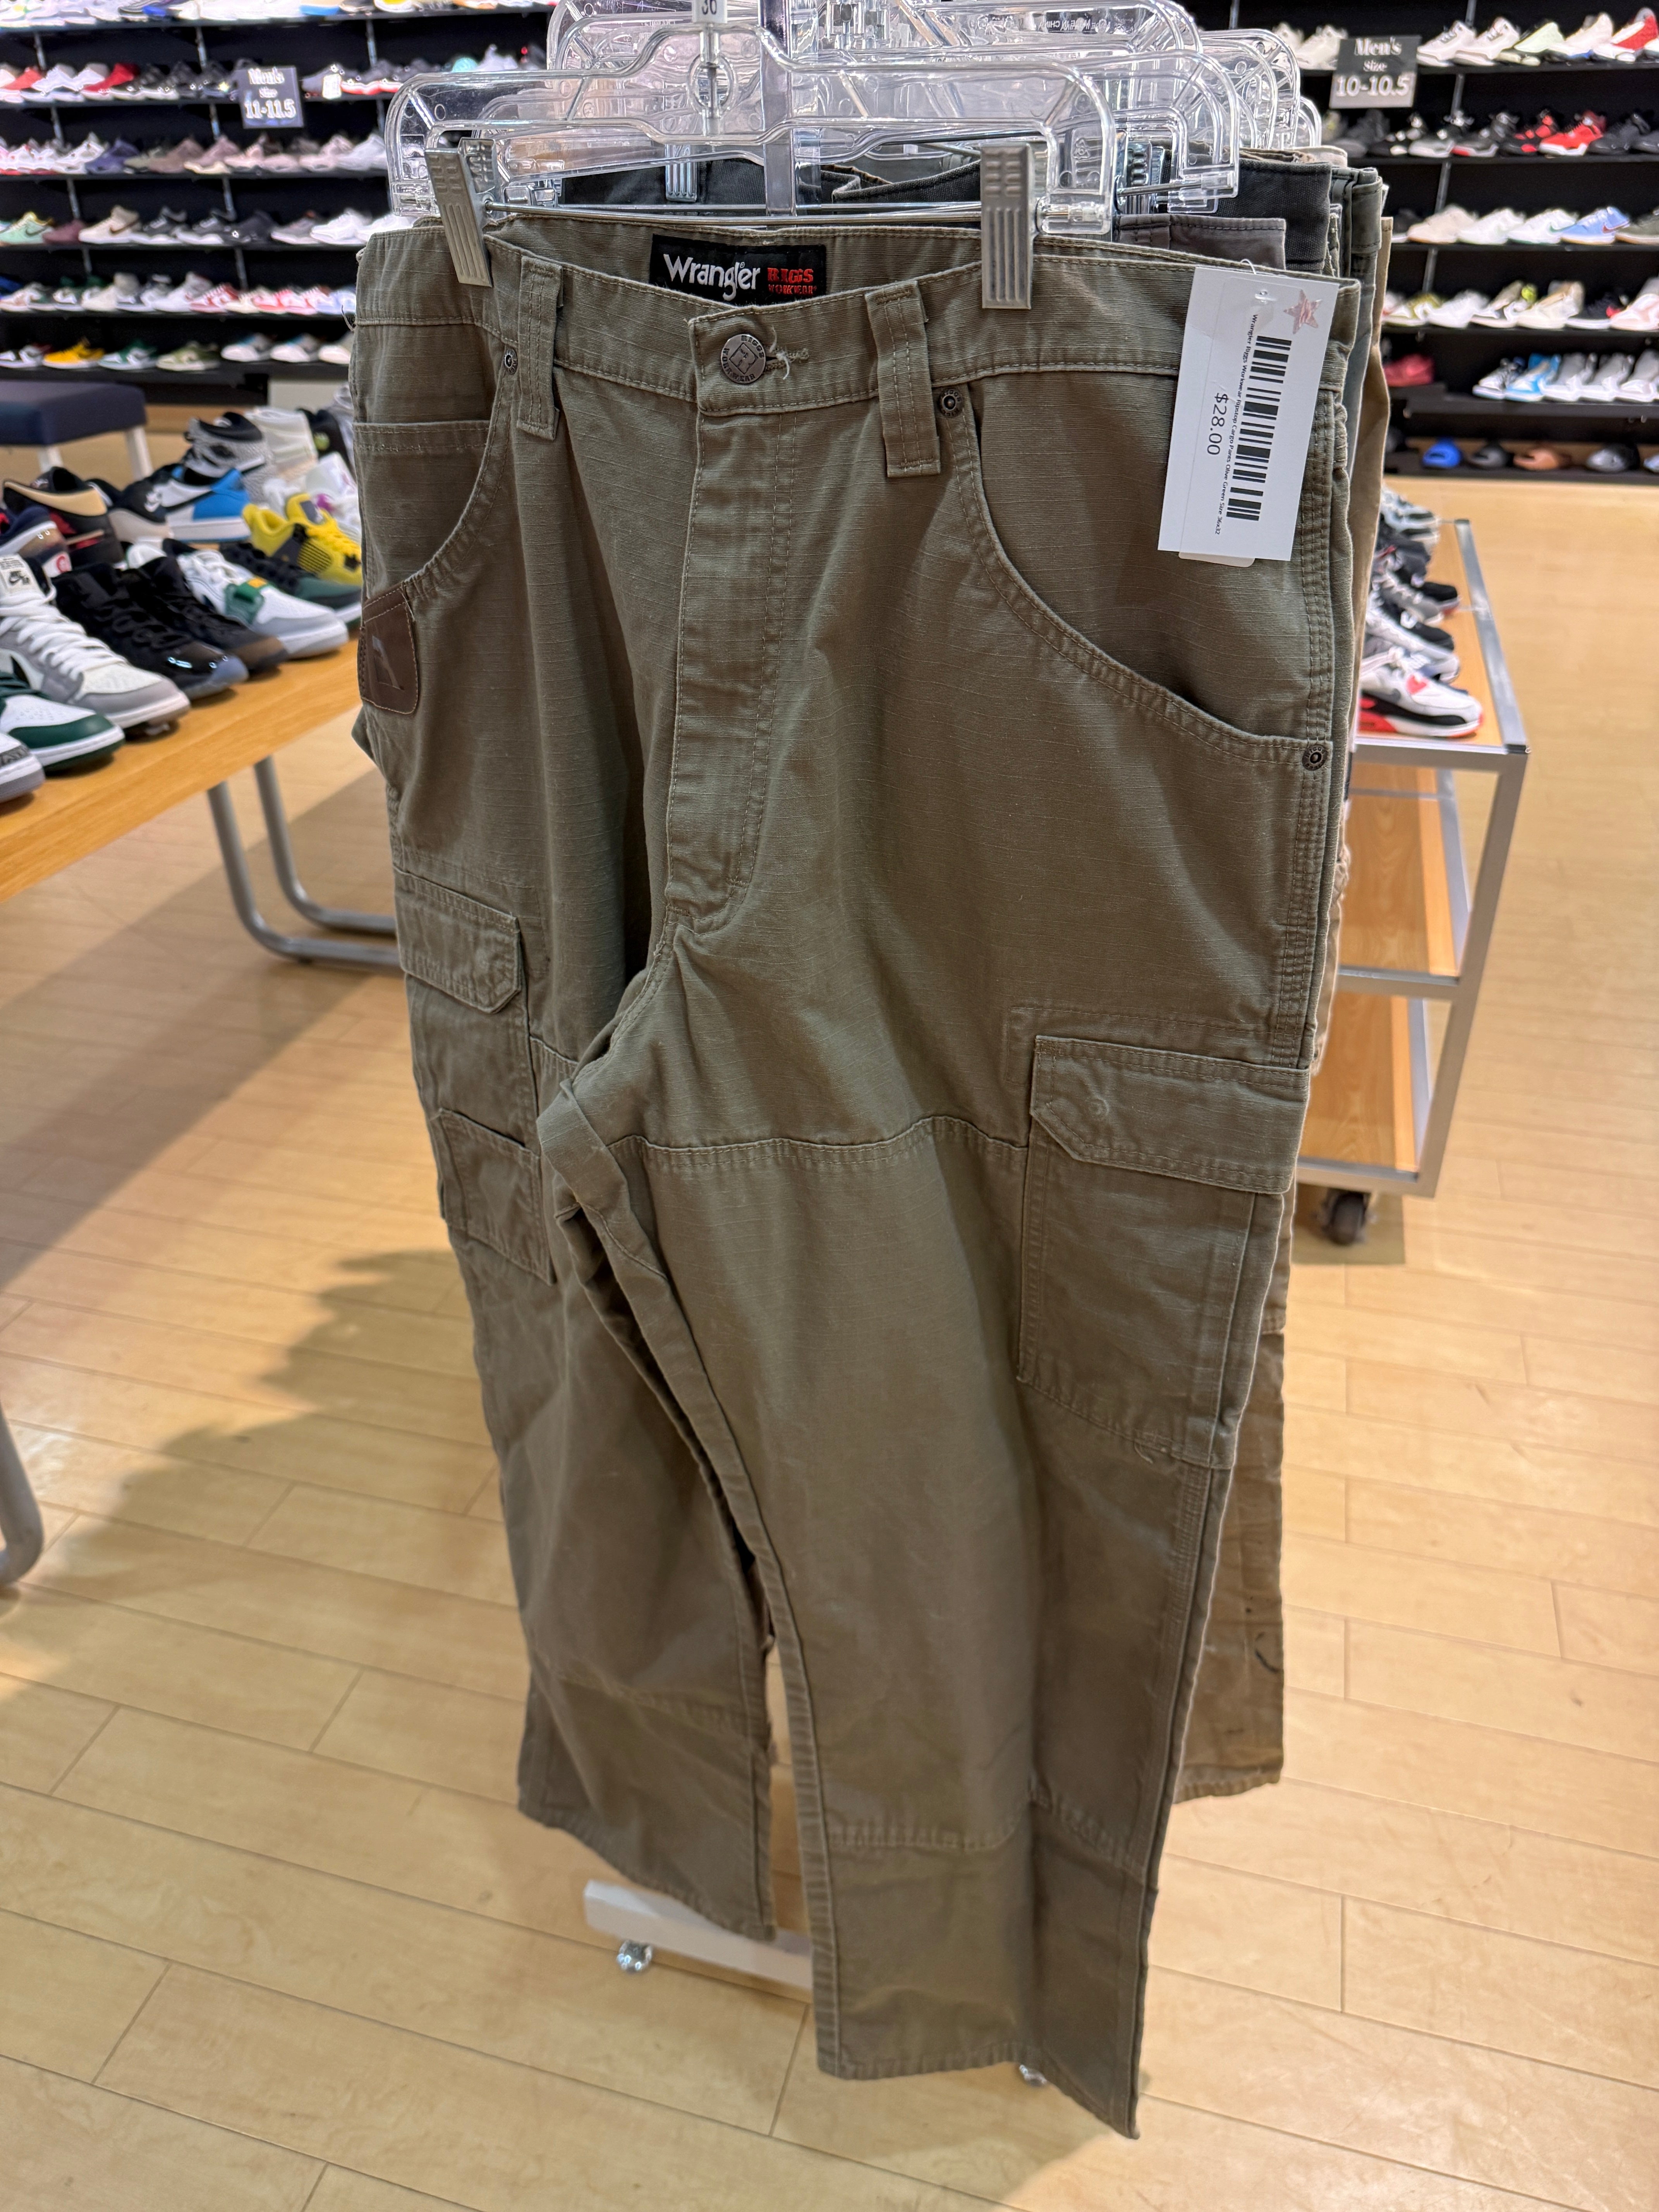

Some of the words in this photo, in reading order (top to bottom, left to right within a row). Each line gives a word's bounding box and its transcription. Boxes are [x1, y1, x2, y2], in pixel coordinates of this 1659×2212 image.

[1354, 36, 1401, 56] Men's
[1336, 74, 1411, 96] 10-10.5
[663, 254, 760, 301] Wrangler
[768, 268, 814, 283] RIGGS
[1247, 314, 1258, 344] Wrangler
[1243, 347, 1251, 363] Riggs
[1238, 365, 1247, 398] Workwear
[1232, 400, 1241, 423] Ripstop
[1207, 393, 1229, 455] $28.00
